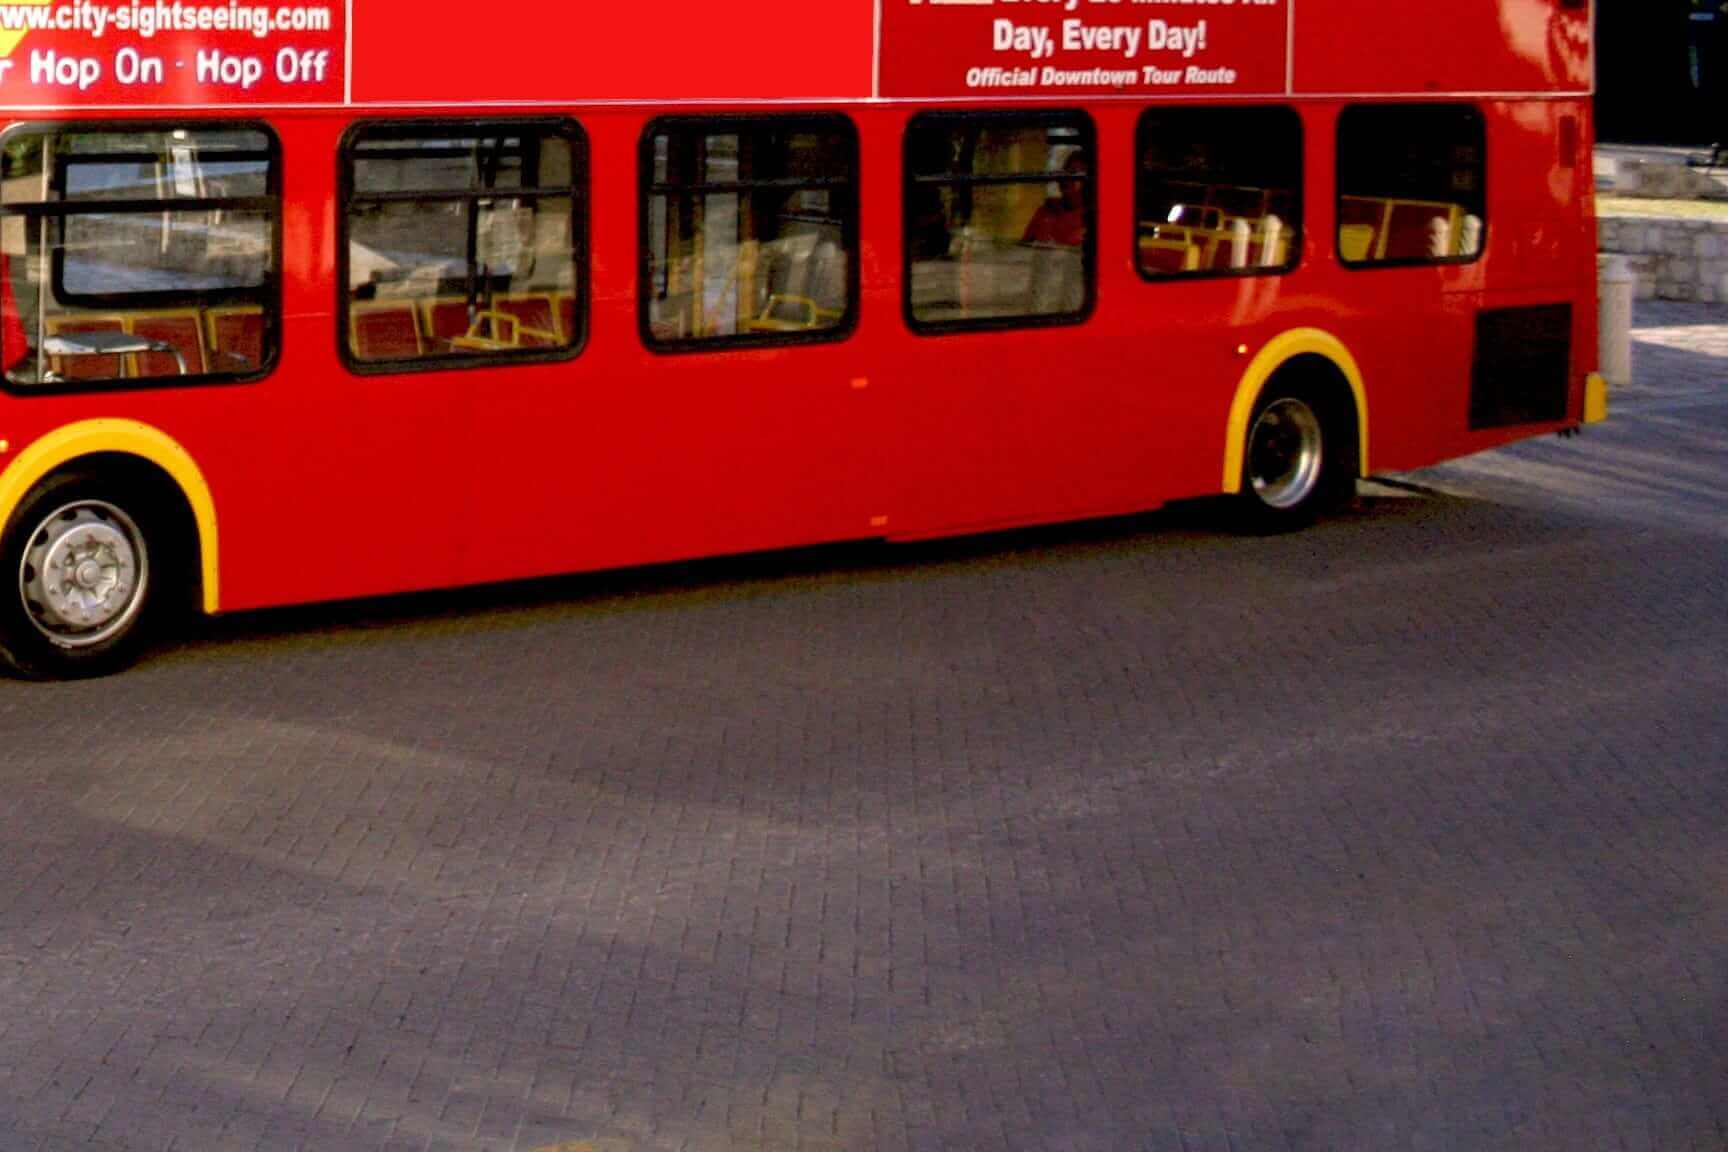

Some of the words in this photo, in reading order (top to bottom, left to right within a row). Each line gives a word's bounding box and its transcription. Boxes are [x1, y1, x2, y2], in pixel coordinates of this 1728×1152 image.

[991, 18, 1055, 58] Day,
[1061, 18, 1142, 58] Every
[1147, 18, 1207, 58] Day!
[29, 49, 101, 90] Hop
[114, 47, 163, 84] On
[196, 49, 263, 89] Hop
[275, 47, 329, 83] Off
[965, 66, 1038, 87] Official
[1040, 66, 1138, 87] Downtown
[1142, 66, 1183, 85] Tour
[1184, 65, 1237, 85] Route
